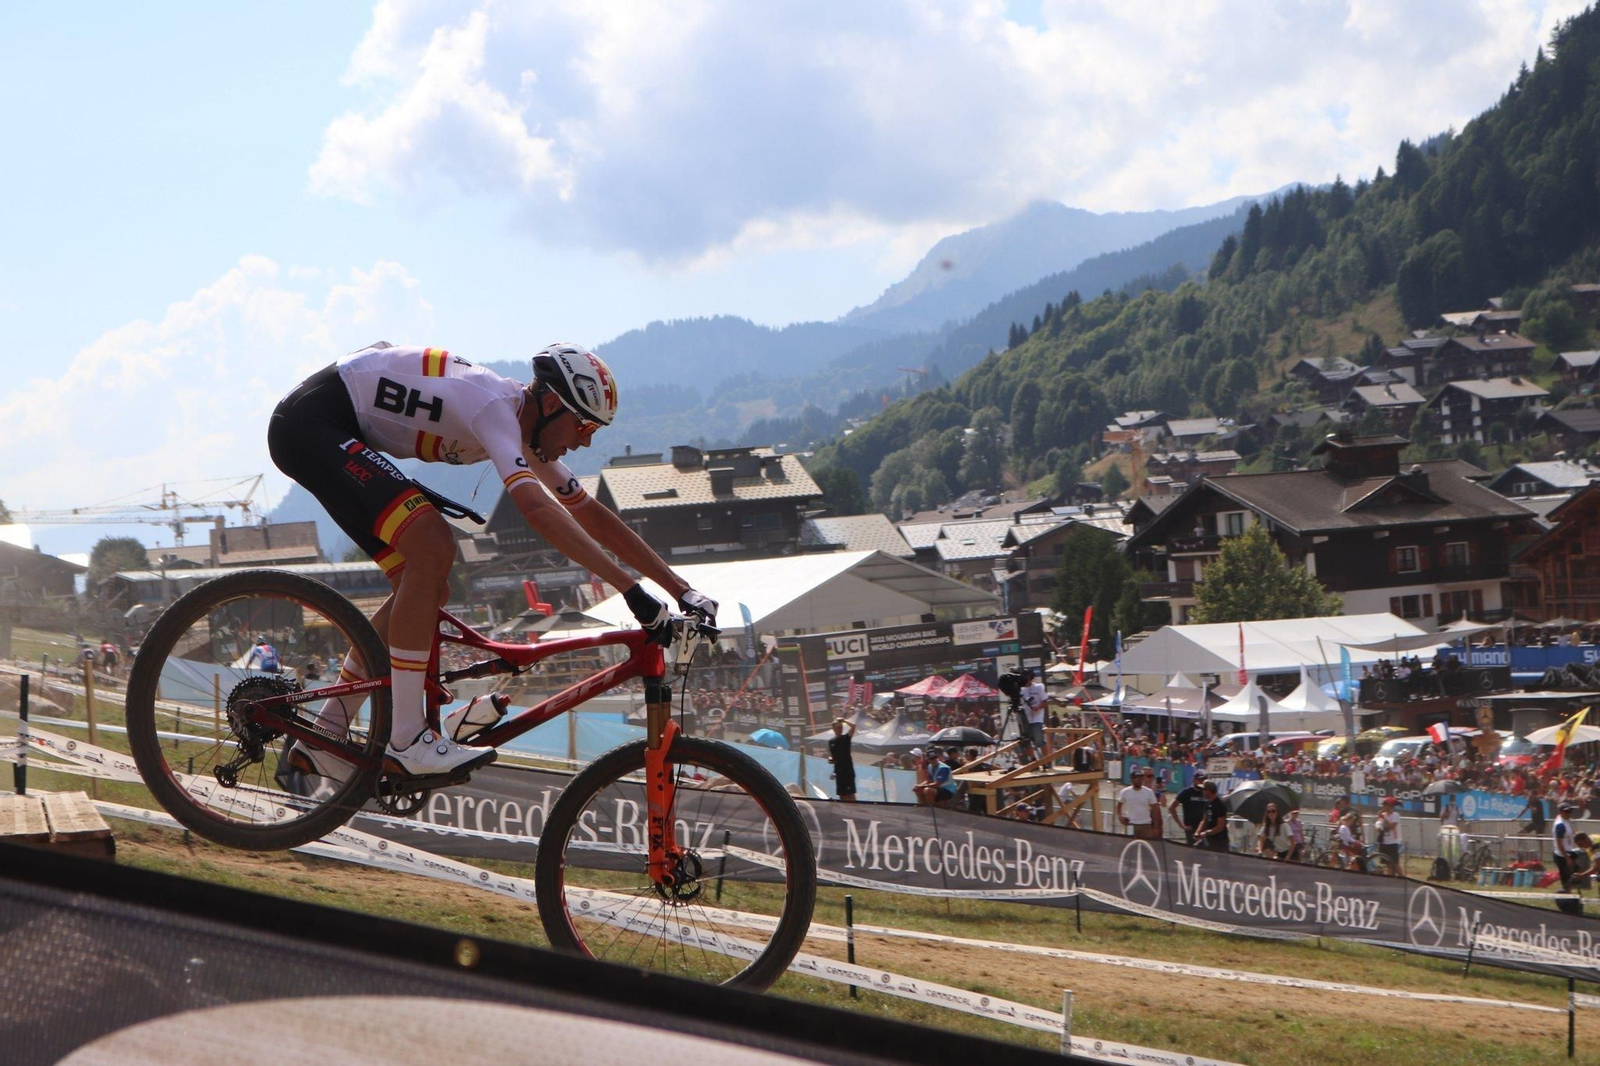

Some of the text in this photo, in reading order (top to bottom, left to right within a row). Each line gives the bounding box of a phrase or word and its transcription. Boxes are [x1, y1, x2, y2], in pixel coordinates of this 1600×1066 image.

[559, 354, 575, 375] LAZER
[373, 376, 443, 423] BH
[361, 447, 404, 481] TEMPLO
[833, 638, 865, 655] UCI
[871, 636, 950, 652] WORLD CHAMPIONSHIPS
[886, 631, 921, 642] MOUNTAIN
[922, 629, 937, 637] BIKE
[544, 670, 616, 714] BH
[312, 724, 348, 746] SHIMANO
[1477, 797, 1490, 810] La
[652, 816, 664, 851] FOX
[842, 818, 1086, 891] Mercedes-Benz
[1174, 860, 1381, 931] Mercedes-Benz
